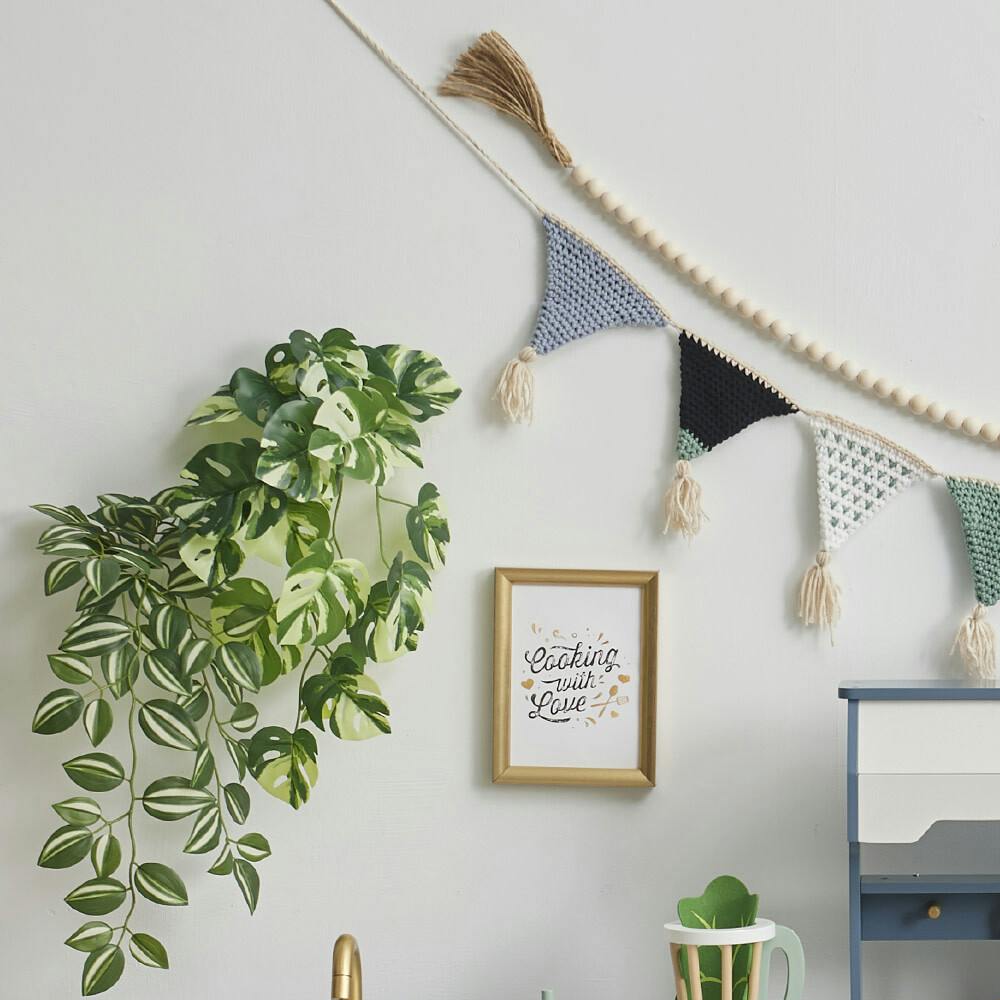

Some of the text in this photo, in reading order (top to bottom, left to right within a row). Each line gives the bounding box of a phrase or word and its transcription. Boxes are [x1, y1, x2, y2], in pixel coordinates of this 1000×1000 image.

[525, 642, 620, 673] Cooking
[541, 671, 596, 692] with
[529, 690, 587, 722] Love
